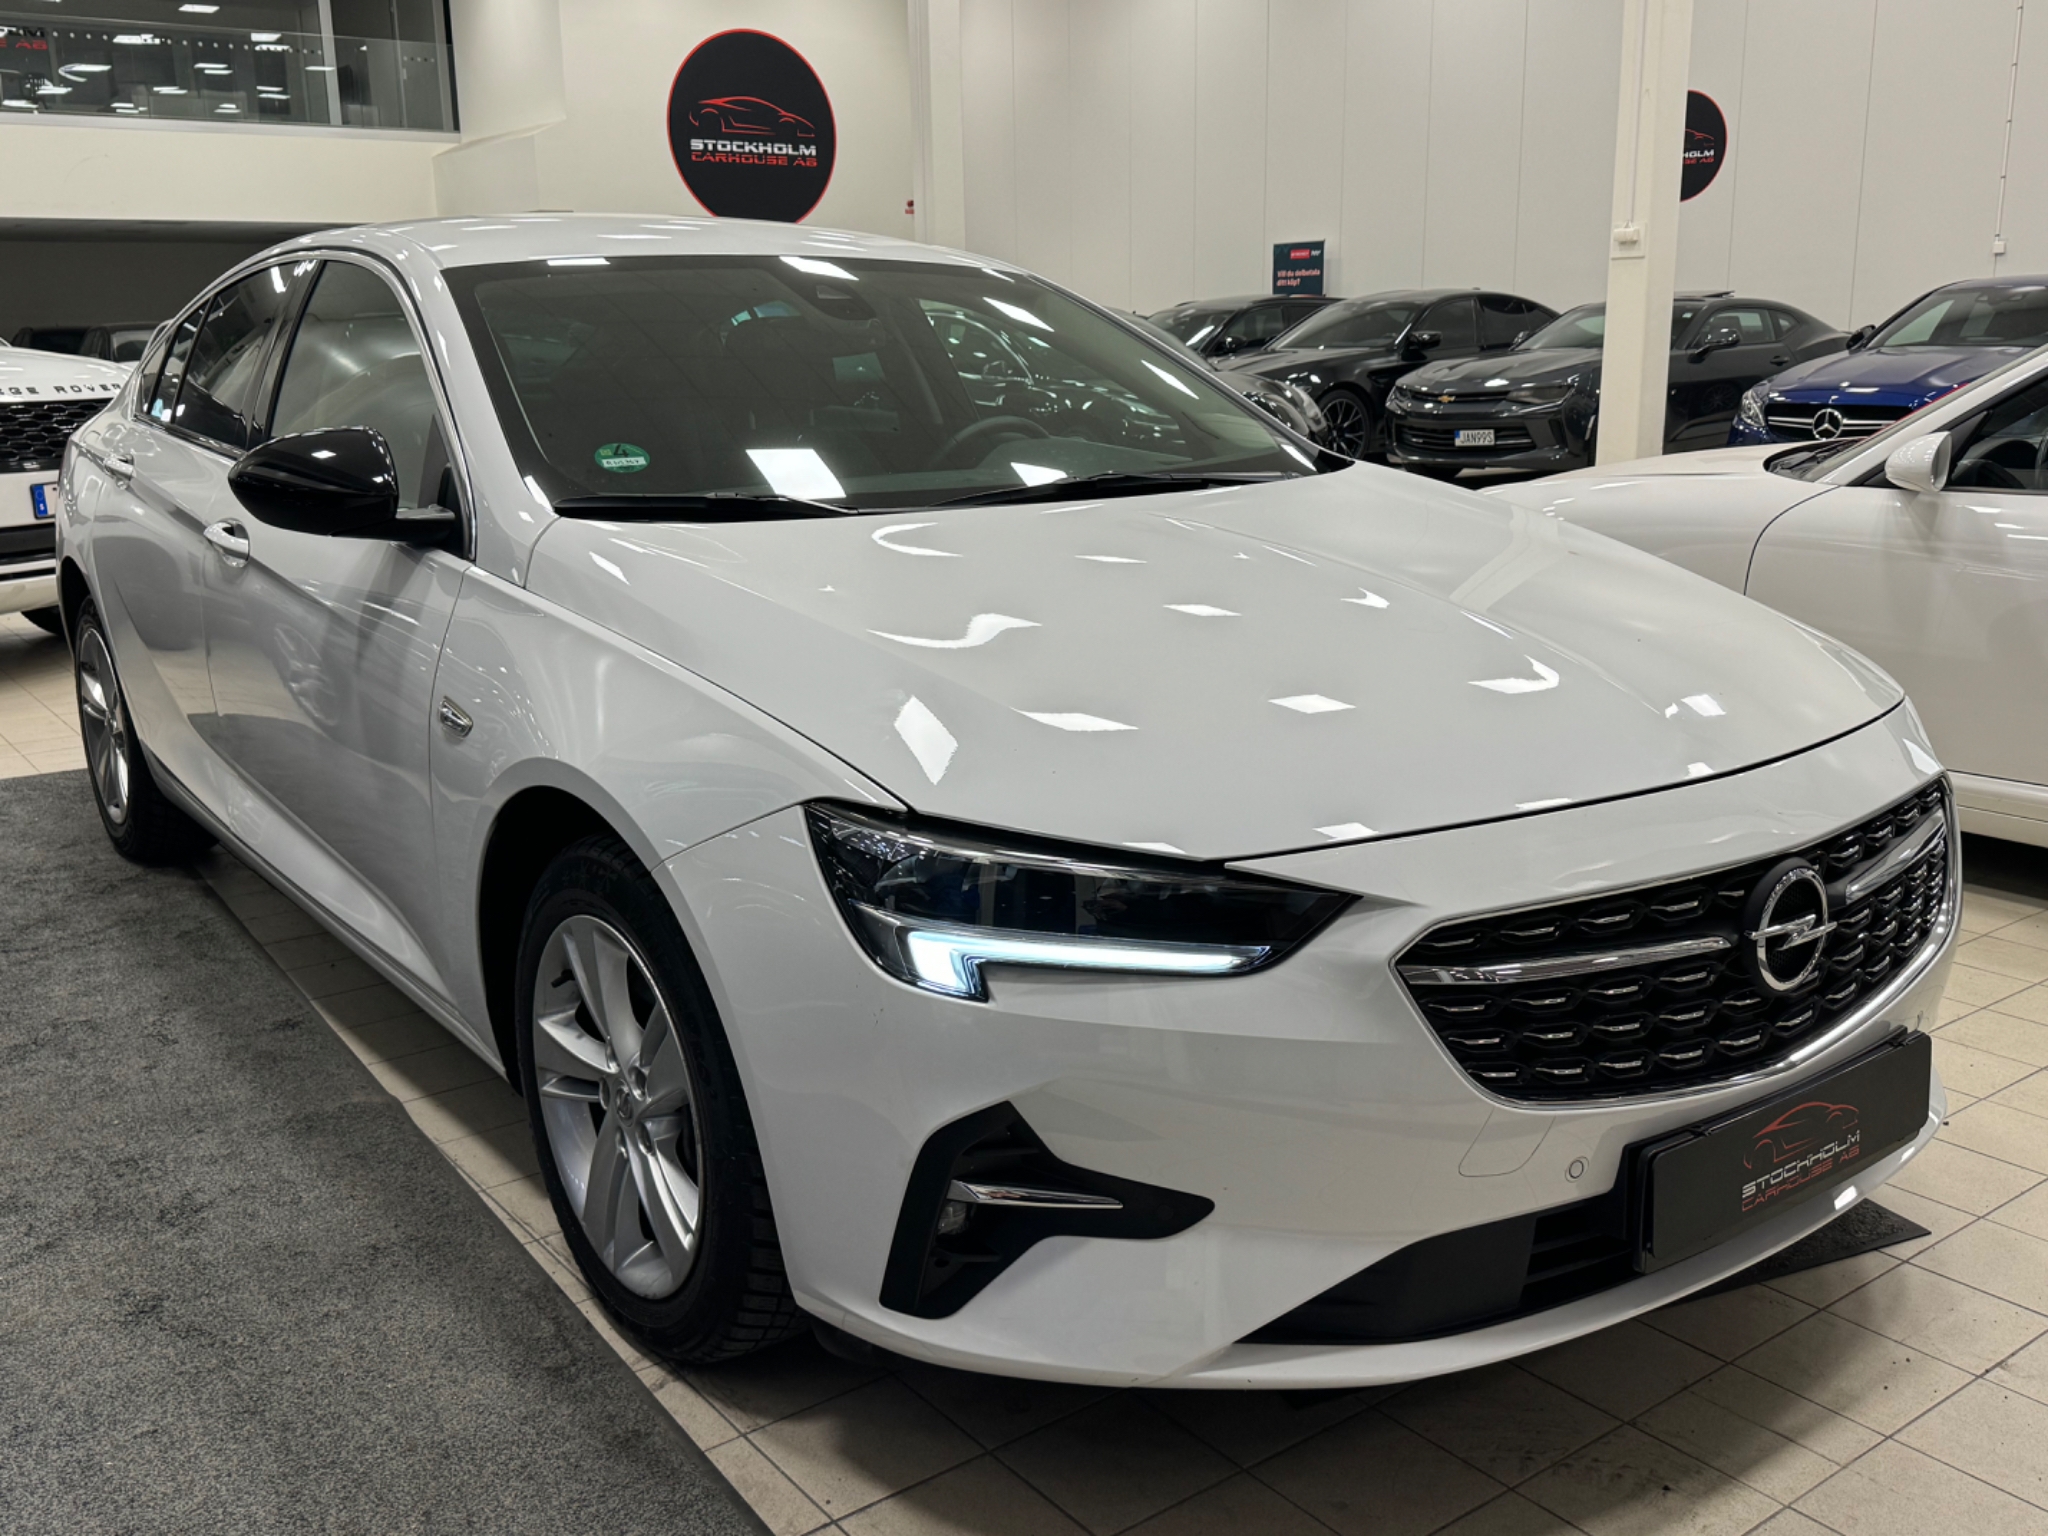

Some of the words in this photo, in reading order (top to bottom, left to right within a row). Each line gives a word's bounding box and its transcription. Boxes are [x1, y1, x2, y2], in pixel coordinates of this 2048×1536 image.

[689, 138, 817, 156] STOCKHOLM
[690, 151, 788, 166] CARHOUSE
[53, 382, 122, 394] ROVER
[613, 443, 630, 457] 4
[1741, 1129, 1860, 1199] STOCKHOLM
[1741, 1157, 1834, 1212] CARHOUSE
